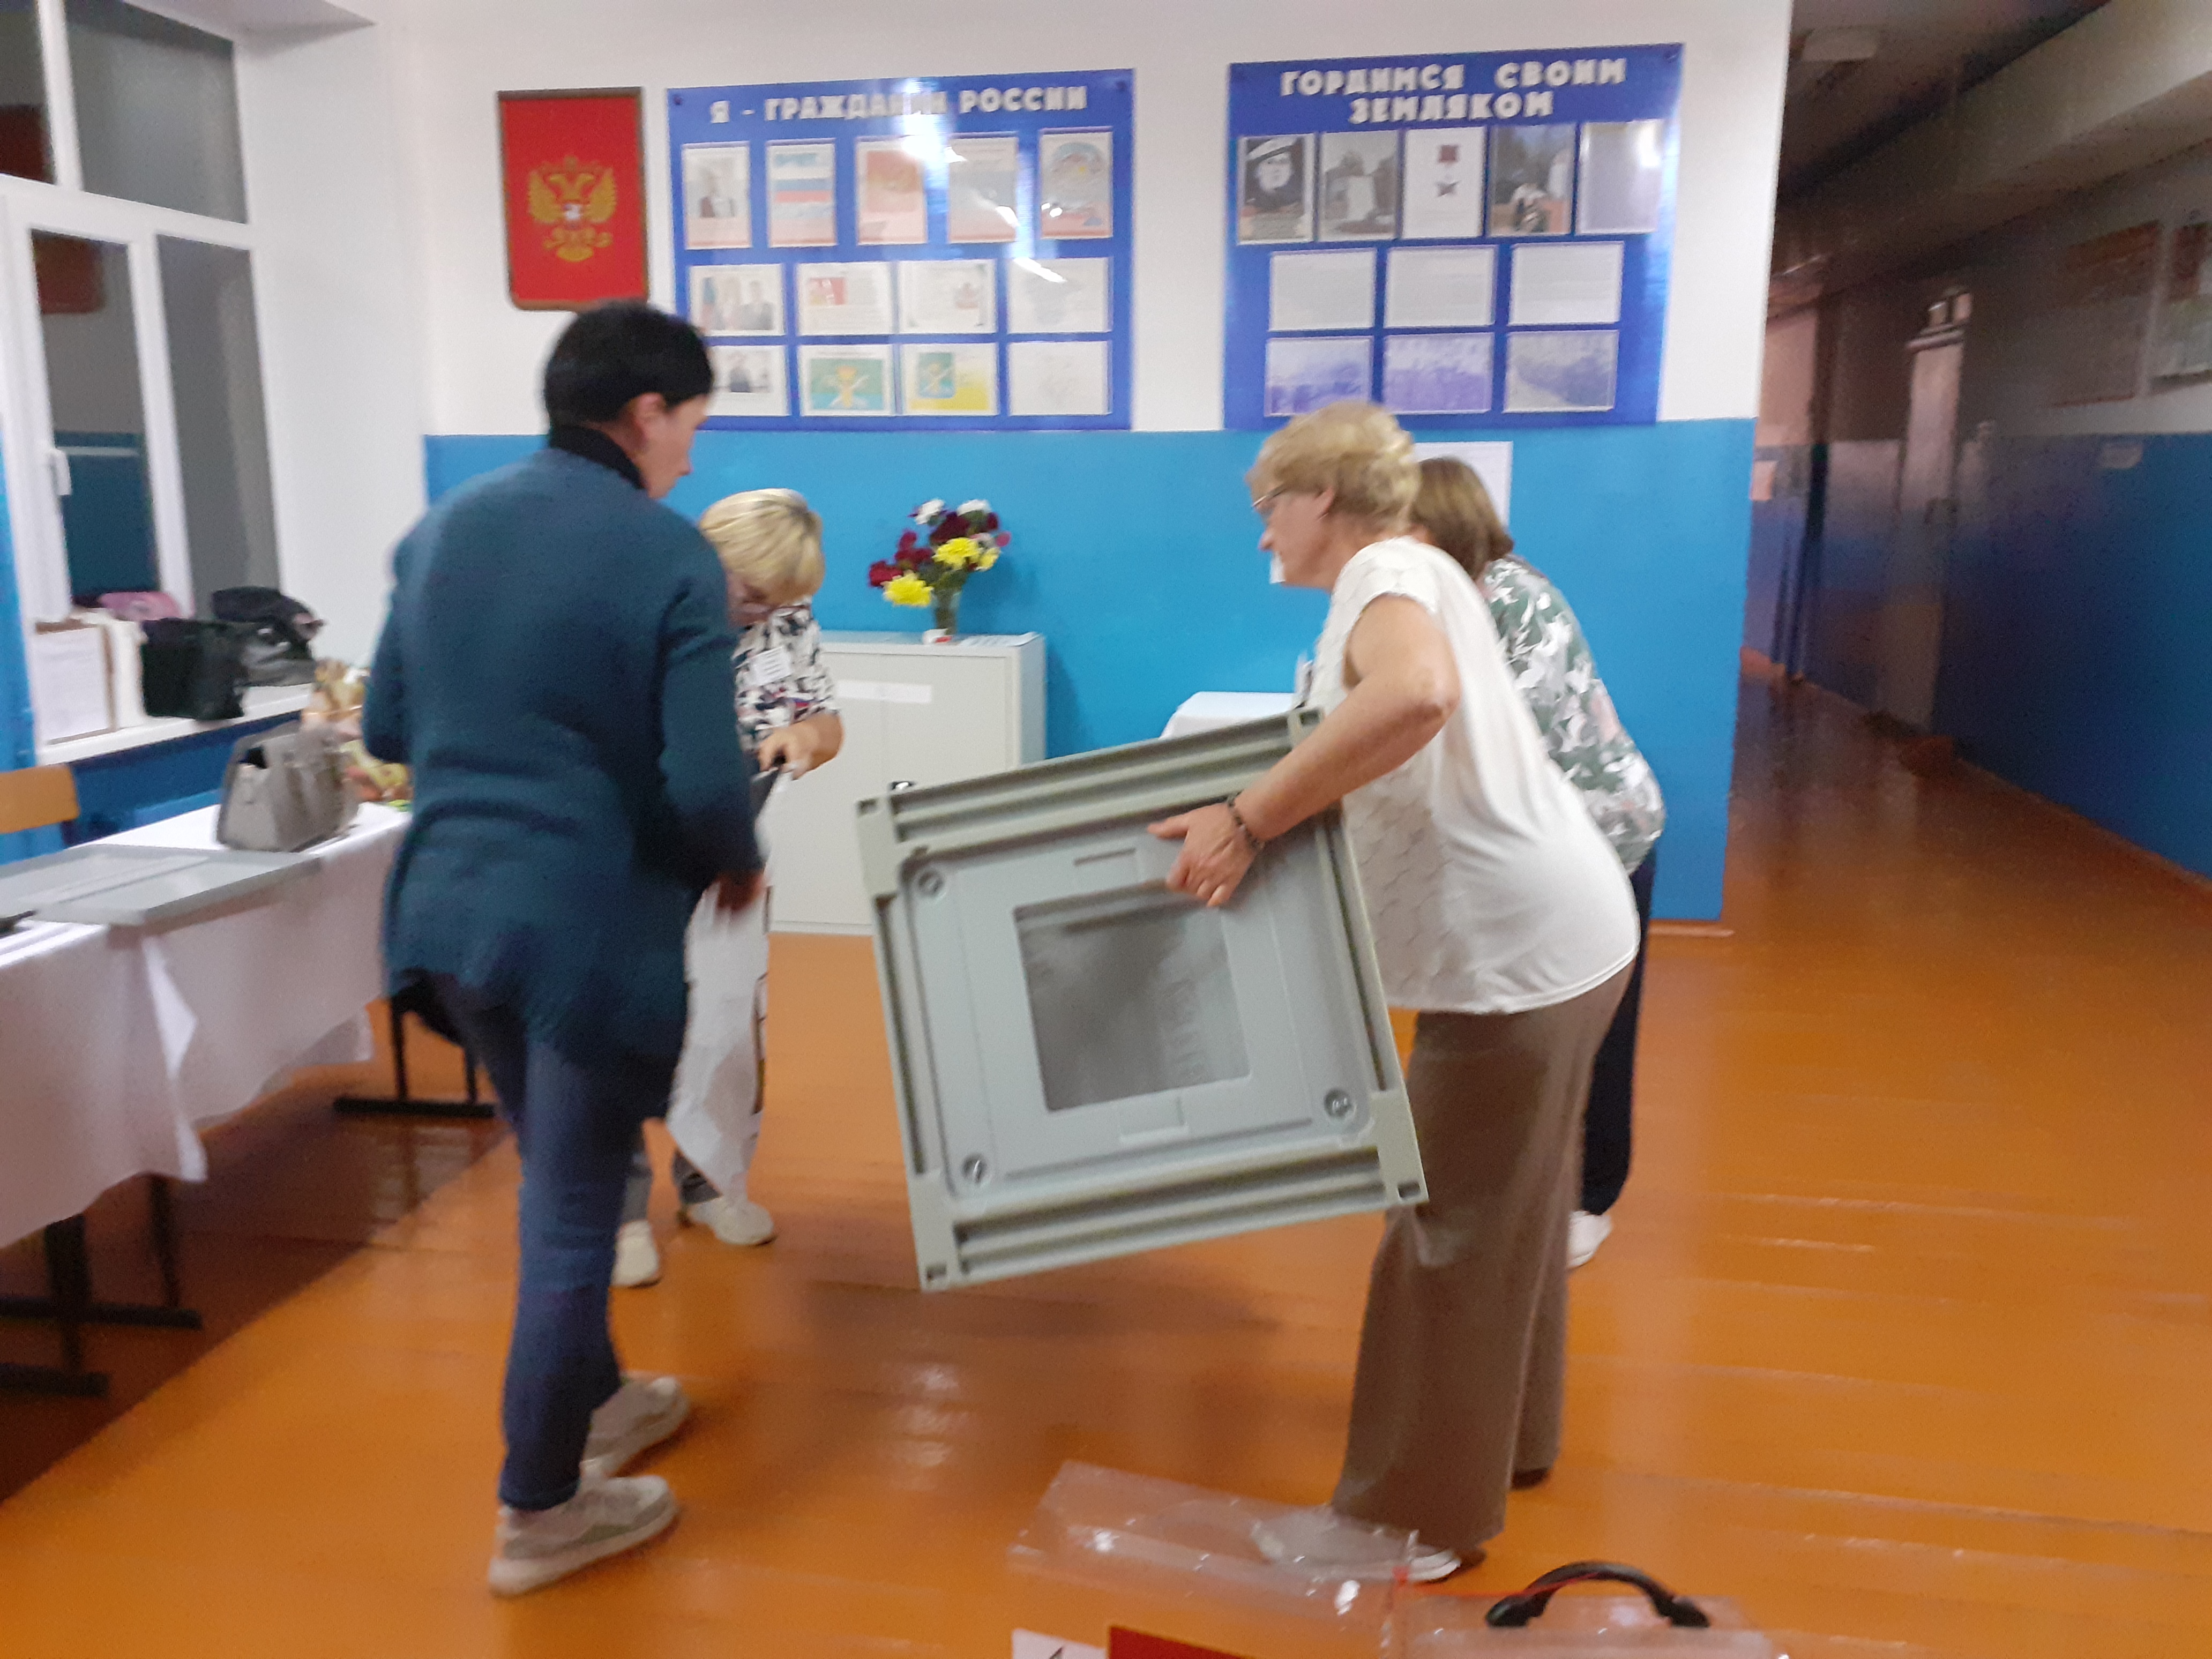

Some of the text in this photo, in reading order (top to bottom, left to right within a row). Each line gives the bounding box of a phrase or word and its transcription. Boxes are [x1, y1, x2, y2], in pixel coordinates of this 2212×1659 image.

[1280, 58, 1626, 96] ГОРДИМСЯ СВОИМ
[710, 100, 730, 124] Я
[959, 86, 1087, 114] РОССИИ
[1348, 91, 1553, 124] ЗЕМЛЯКОМ
